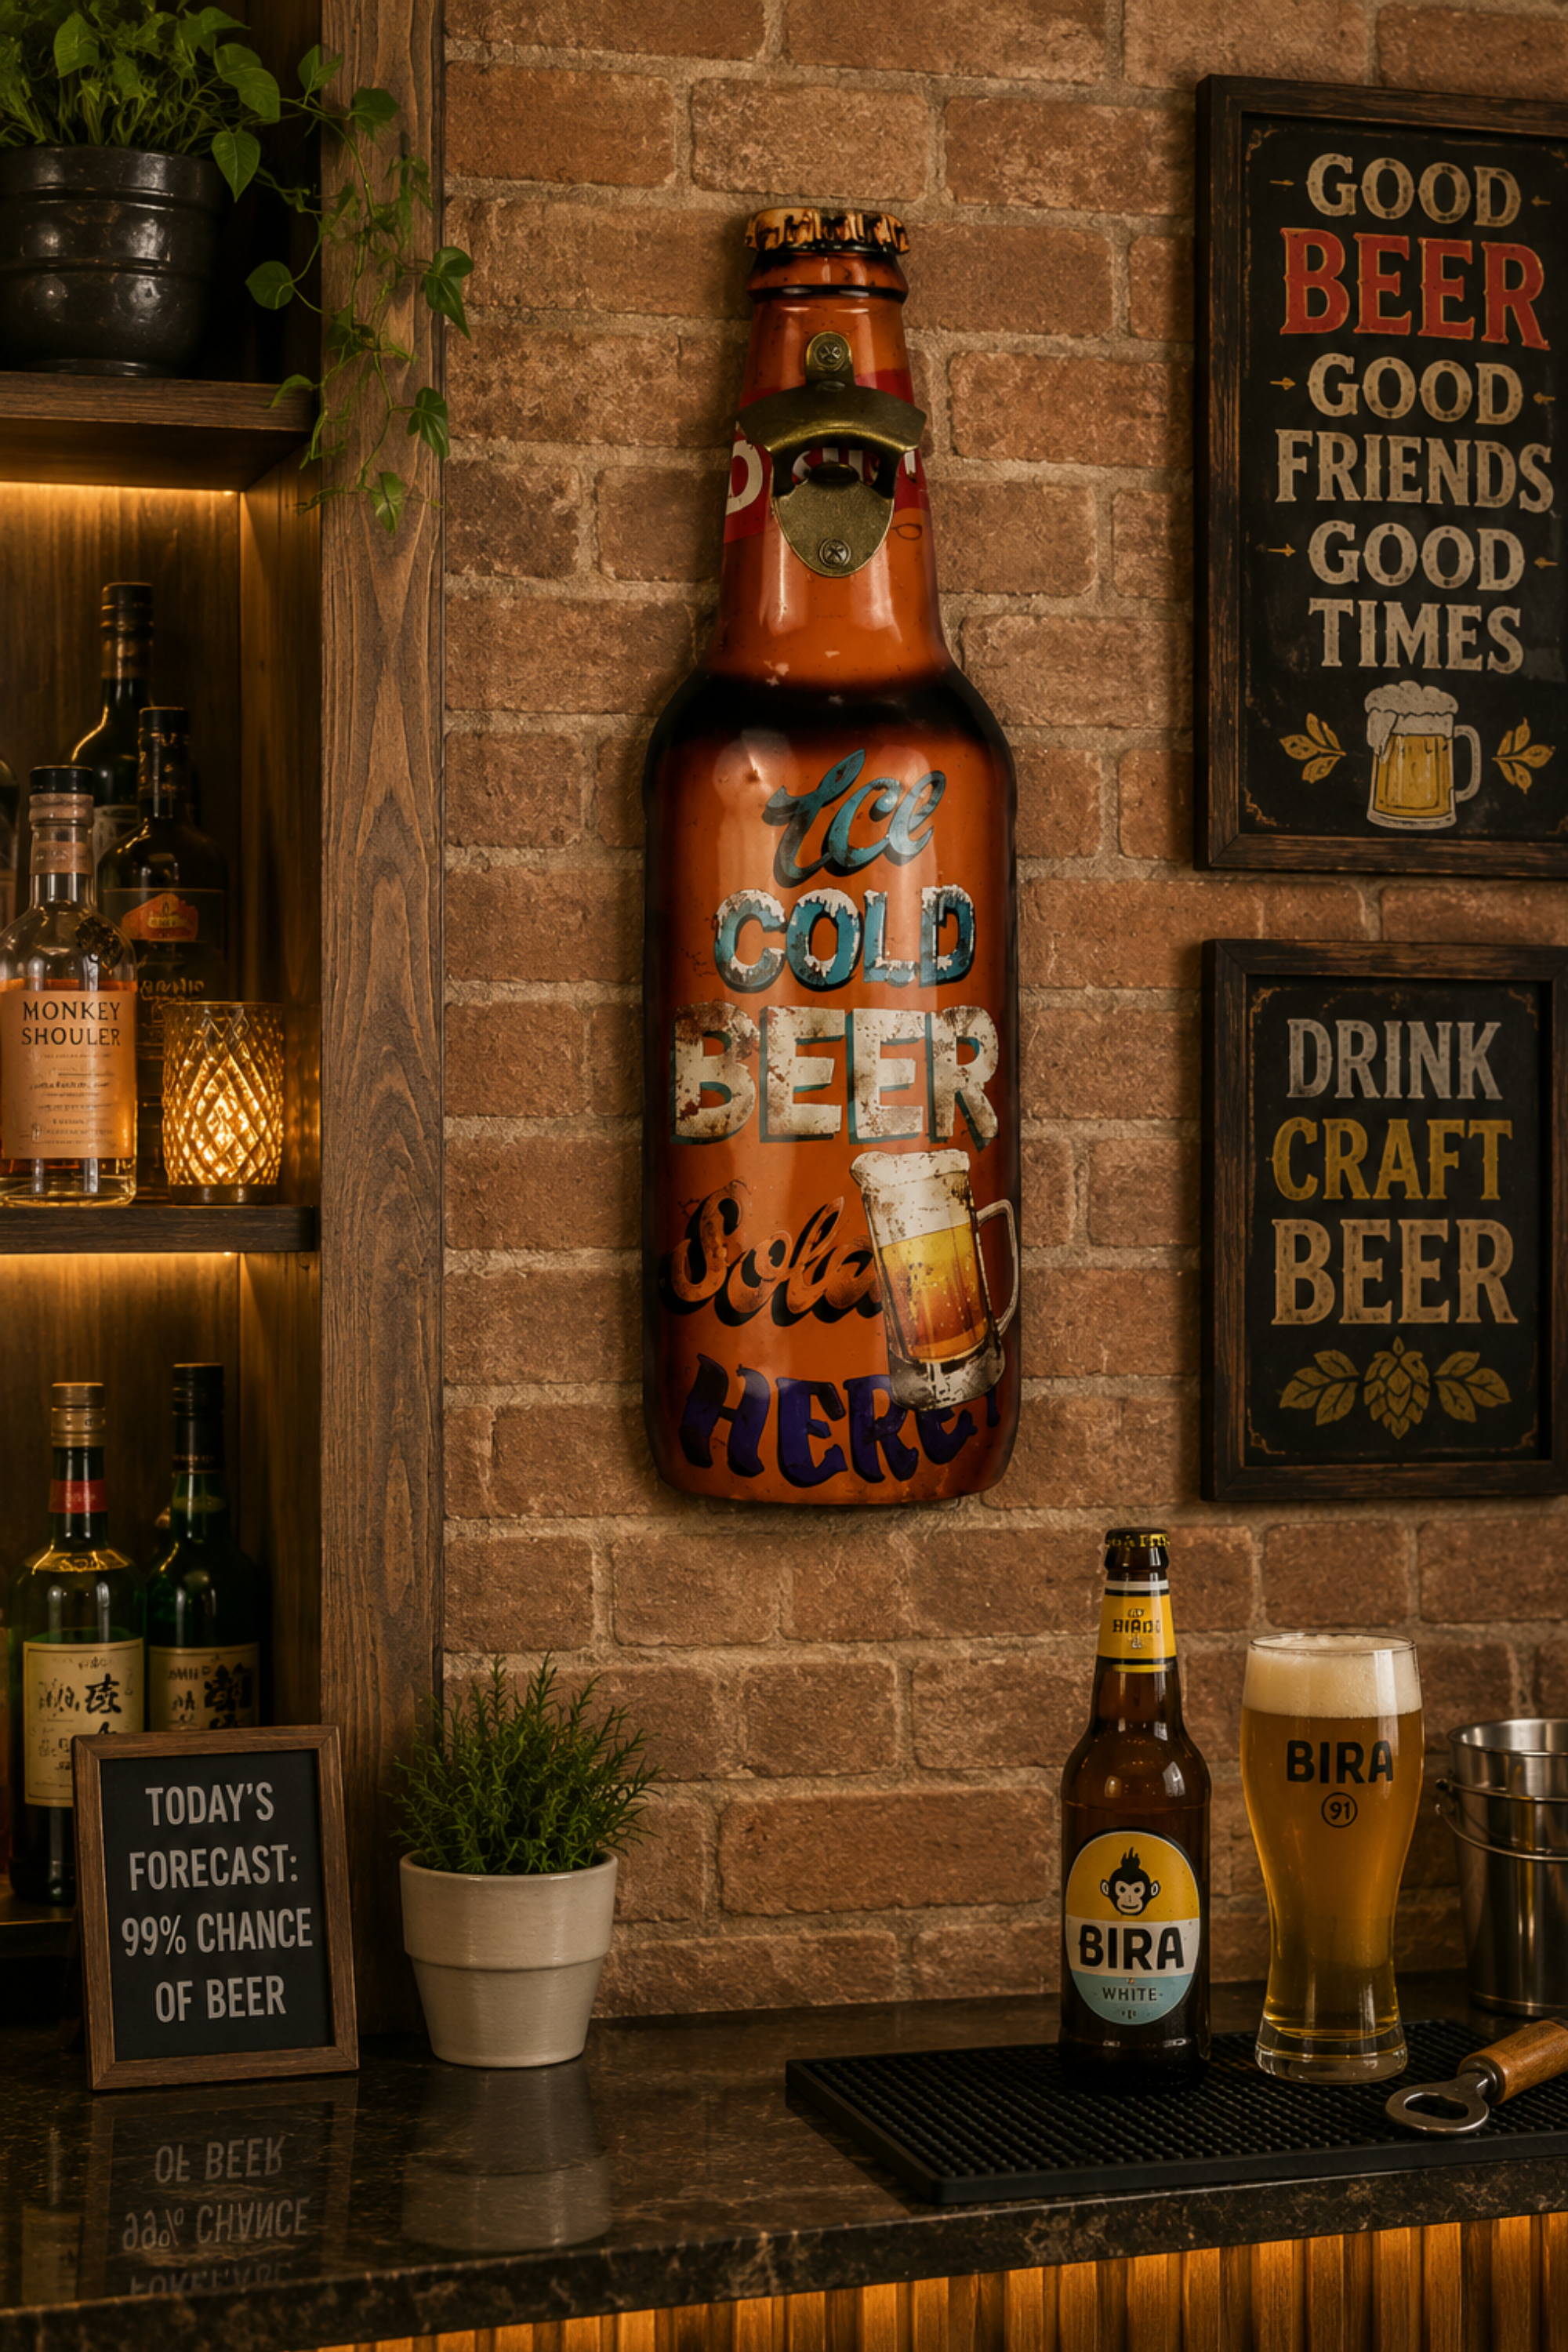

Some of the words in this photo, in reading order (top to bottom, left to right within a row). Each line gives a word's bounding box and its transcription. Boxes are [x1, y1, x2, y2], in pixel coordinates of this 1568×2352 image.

[1306, 153, 1522, 227] GOOD
[1279, 227, 1551, 350] BEER
[1307, 353, 1523, 426] GOOD
[1276, 428, 1555, 513] FRIENDS
[1308, 520, 1526, 591] GOOD
[1308, 597, 1524, 674] TIMES
[762, 748, 947, 888] Ice
[713, 884, 976, 993] COLD
[21, 1026, 121, 1047] SHOULER
[23, 1000, 121, 1021] MONKEY
[670, 1002, 1000, 1152] BEER
[1287, 1018, 1503, 1099] DRINK
[1271, 1116, 1514, 1201] CRAFT
[1271, 1218, 1519, 1326] BEER
[1286, 1740, 1394, 1784] BIRA
[144, 1781, 275, 1827] TODAY'S
[1328, 1801, 1352, 1820] 91
[129, 1843, 299, 1892] FORECAST:
[122, 1915, 187, 1957] 99%
[196, 1907, 314, 1954] CHANCE
[1078, 1924, 1185, 1971] BIRA
[155, 1980, 194, 2023] OF
[206, 1975, 287, 2020] BEER
[1102, 1987, 1157, 2002] WHITE
